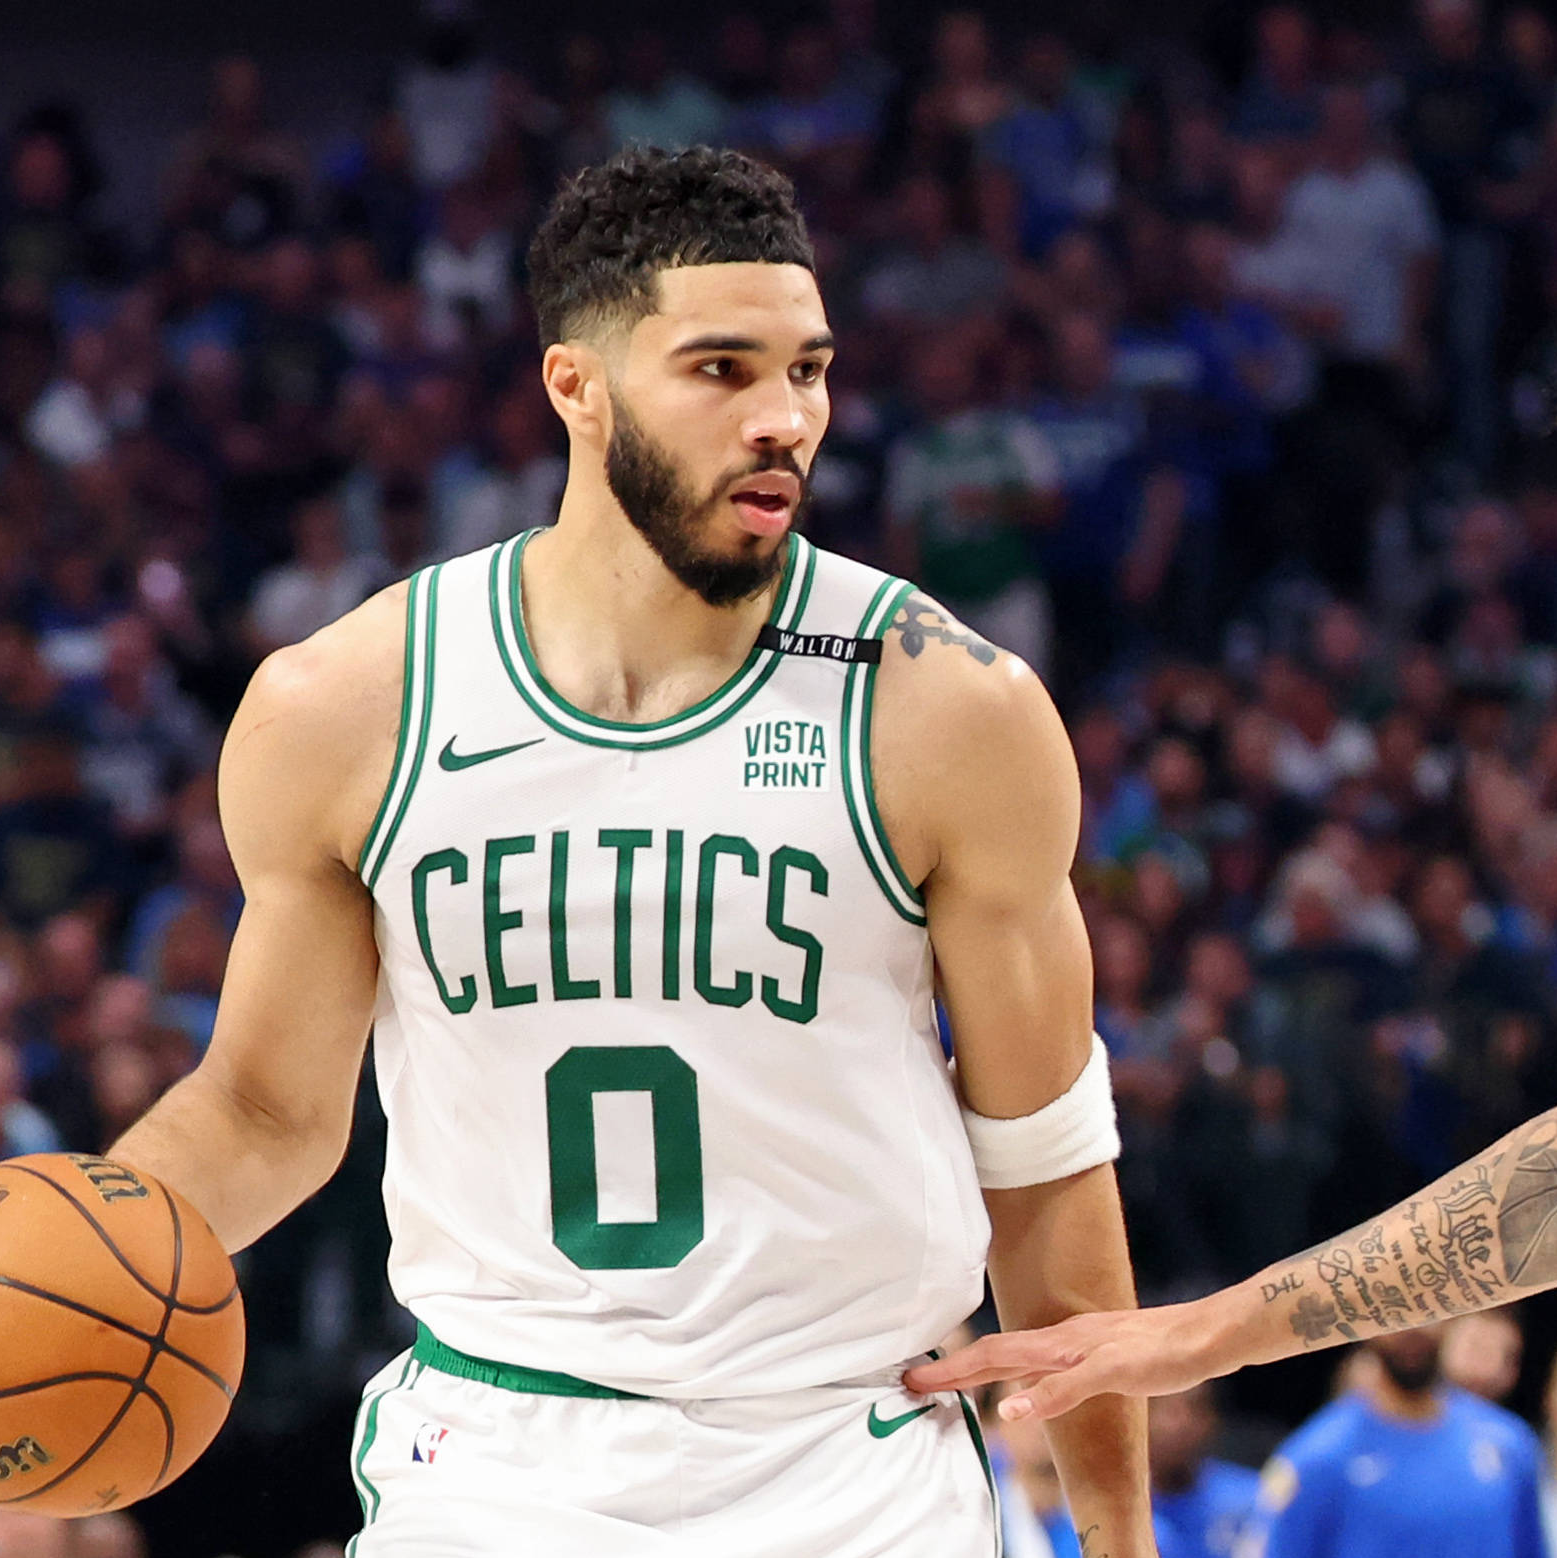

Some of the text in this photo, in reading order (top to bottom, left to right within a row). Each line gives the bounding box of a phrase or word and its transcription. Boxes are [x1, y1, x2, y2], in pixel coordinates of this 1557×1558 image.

[779, 632, 857, 661] WALTON
[744, 720, 826, 759] VISTA
[743, 762, 826, 788] PRINT
[410, 828, 829, 1025] CELTICS
[544, 1045, 705, 1270] 0
